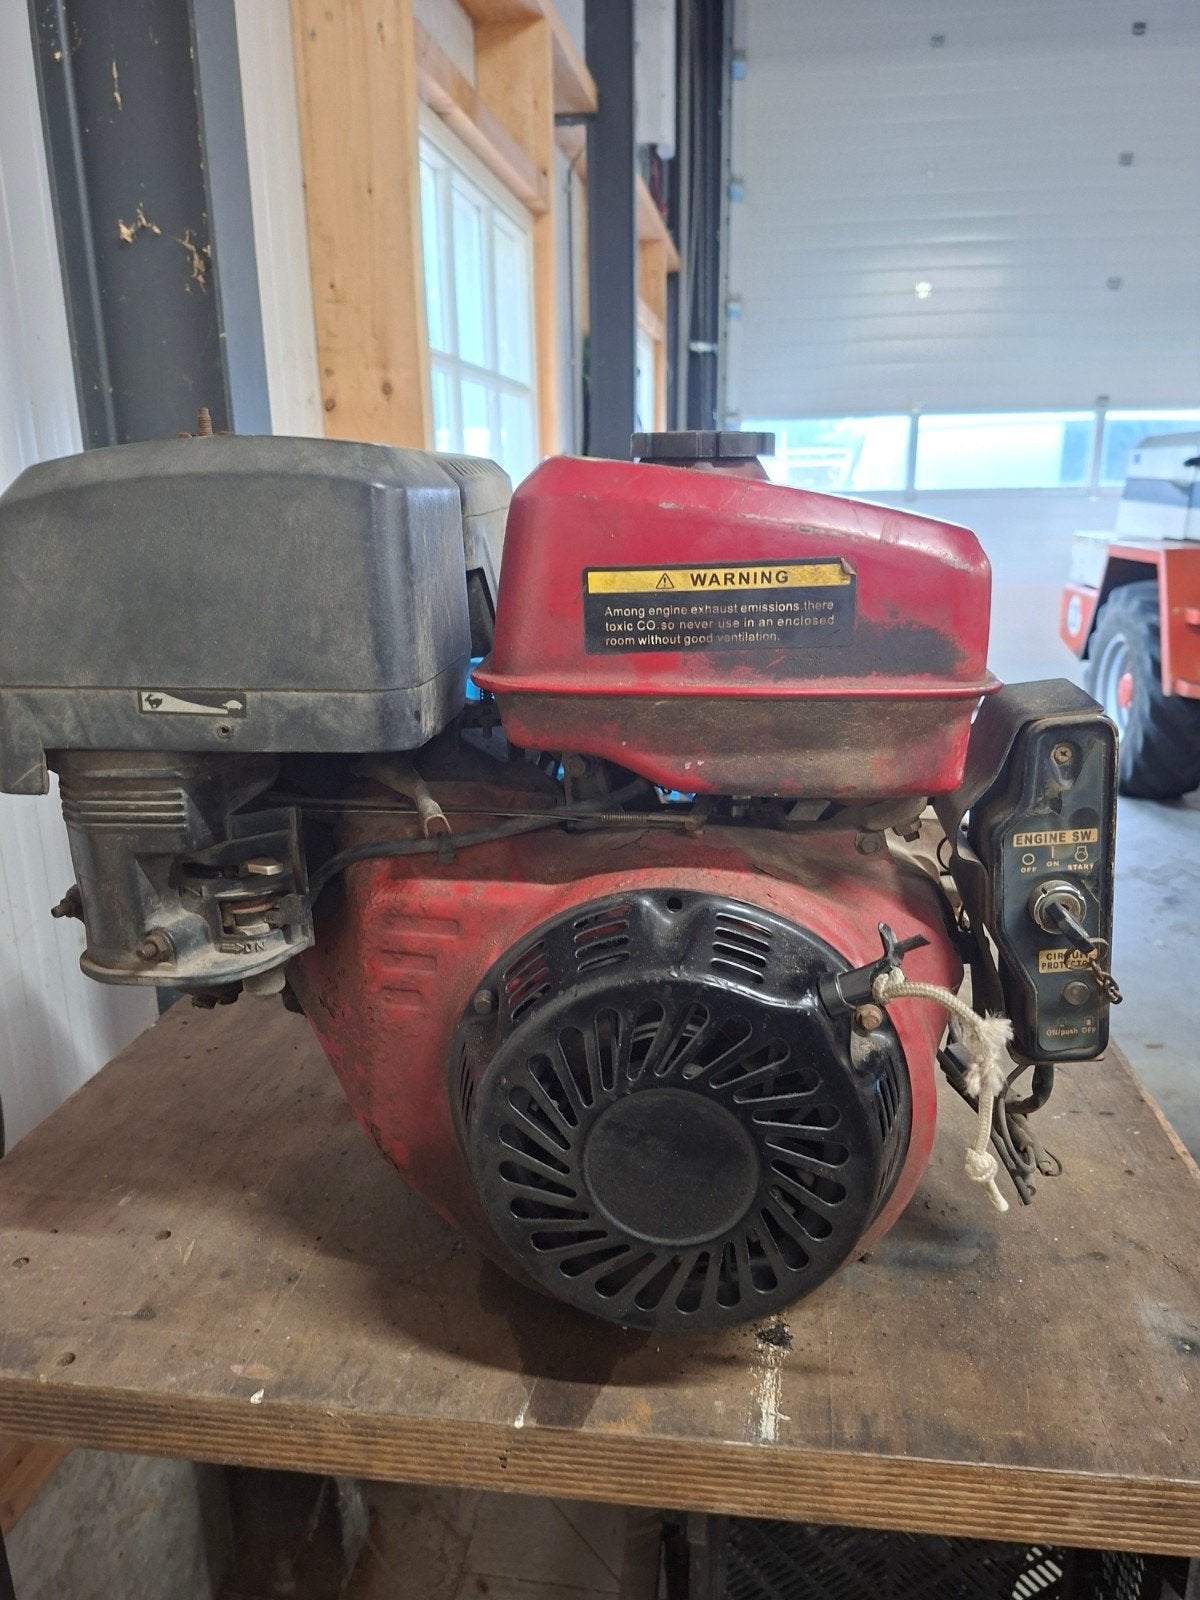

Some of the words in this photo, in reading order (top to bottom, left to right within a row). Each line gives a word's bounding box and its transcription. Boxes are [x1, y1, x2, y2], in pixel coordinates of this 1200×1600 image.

[689, 570, 789, 587] WARNING
[604, 606, 645, 618] Among
[648, 604, 687, 618] engine
[690, 603, 738, 615] exhaust
[605, 620, 634, 632] toxic
[679, 620, 714, 630] never
[718, 619, 740, 629] use
[744, 617, 755, 628] in
[758, 617, 774, 628] an
[777, 614, 835, 627] enclosed
[605, 636, 635, 646] room
[638, 634, 681, 646] without
[683, 633, 713, 646] good
[717, 631, 780, 643] ventilation.
[1015, 832, 1067, 846] ENGINE
[1072, 830, 1096, 842] SW.
[1020, 866, 1037, 874] OFF
[1046, 860, 1060, 868] ON
[1067, 863, 1094, 872] START
[1046, 1026, 1078, 1037] ON/push
[1081, 1026, 1096, 1035] OFF
